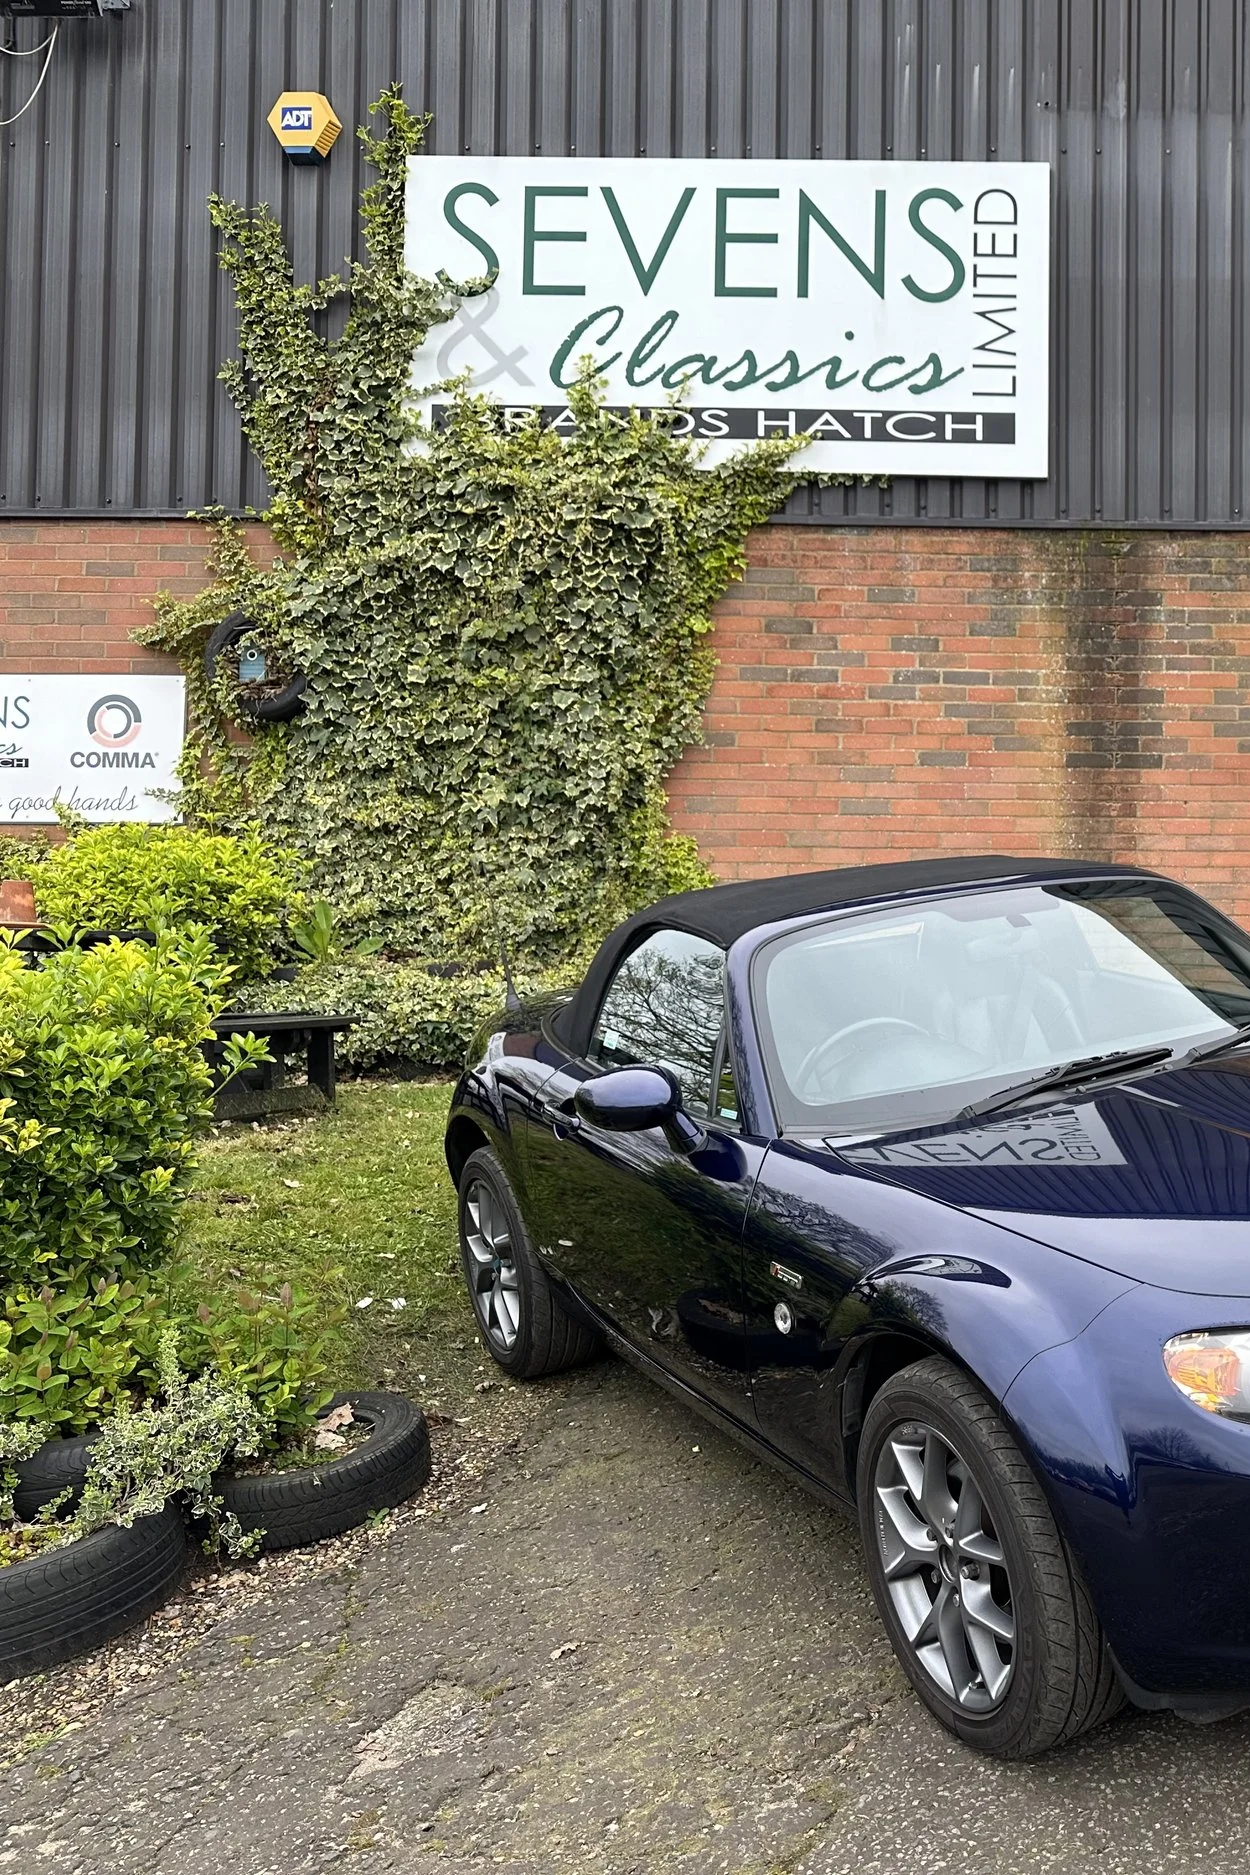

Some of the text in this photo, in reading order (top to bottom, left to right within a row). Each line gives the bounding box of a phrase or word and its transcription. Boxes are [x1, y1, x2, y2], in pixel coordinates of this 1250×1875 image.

[281, 110, 312, 127] ADT
[435, 182, 966, 302] SEVENS
[972, 187, 1018, 398] LIMITED
[549, 305, 965, 395] Classics
[463, 406, 985, 441] RANDS HATCH
[70, 751, 156, 769] COMMA
[9, 785, 139, 819] good hands
